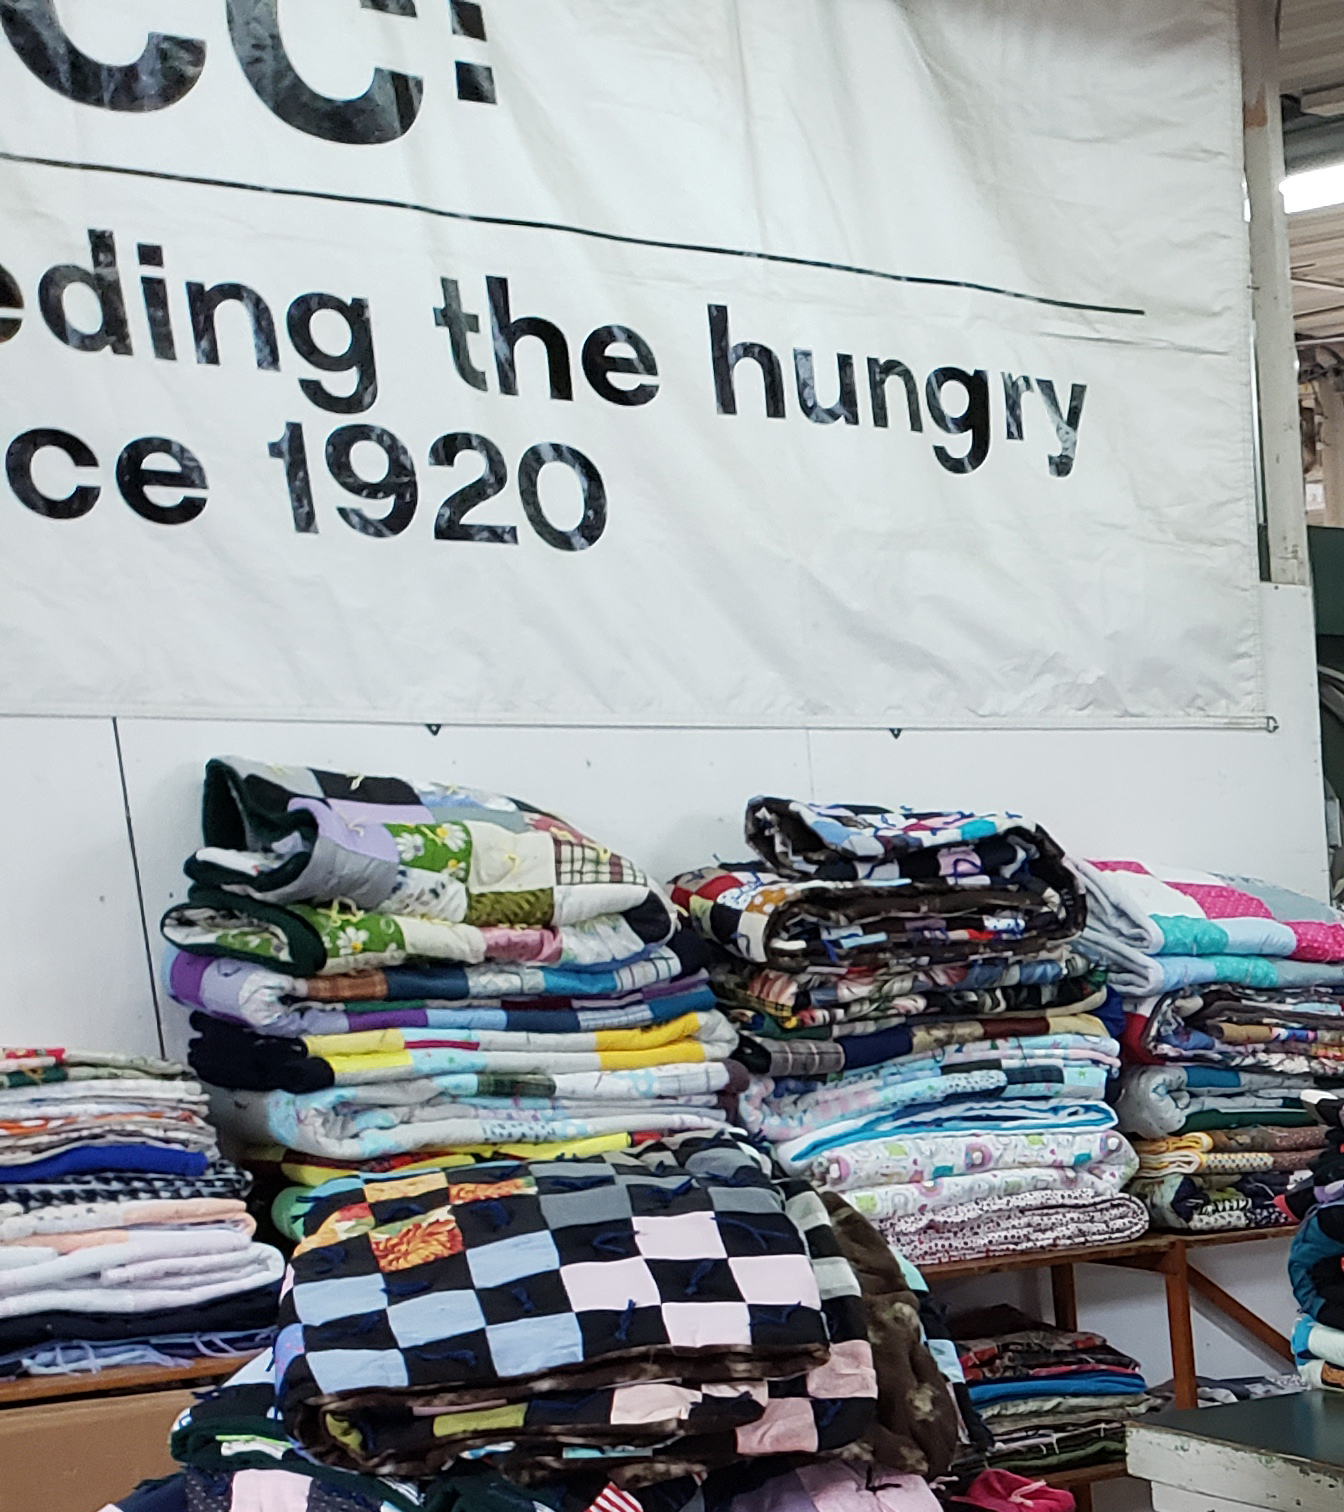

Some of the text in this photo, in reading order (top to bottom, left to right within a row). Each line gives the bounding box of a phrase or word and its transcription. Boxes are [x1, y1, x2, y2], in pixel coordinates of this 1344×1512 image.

[434, 275, 661, 407] the
[707, 303, 1088, 478] hungry
[266, 420, 609, 553] 1920
